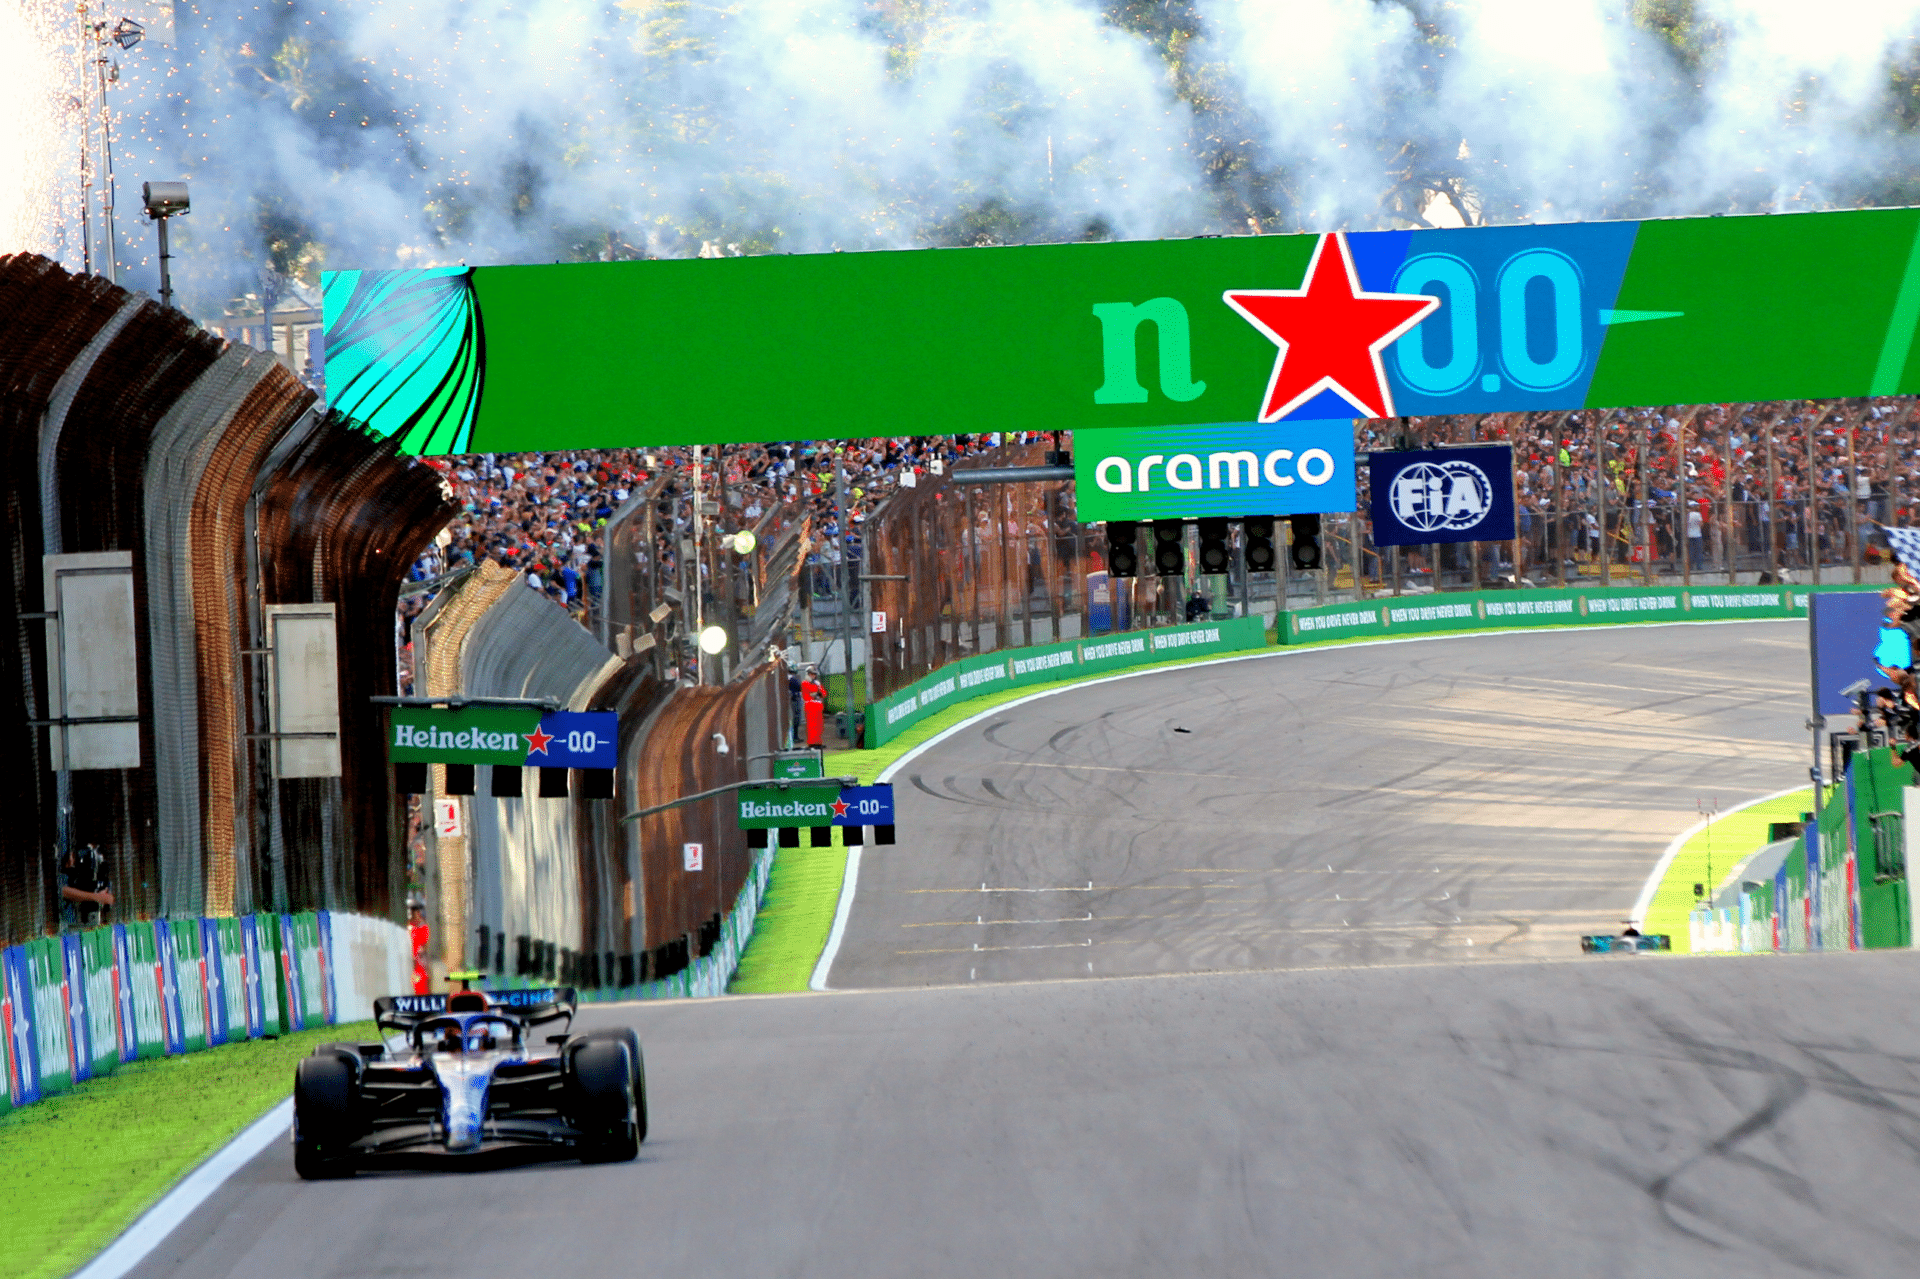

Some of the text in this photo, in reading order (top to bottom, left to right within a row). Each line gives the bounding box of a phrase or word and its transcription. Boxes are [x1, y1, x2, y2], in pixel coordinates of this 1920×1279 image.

[1092, 250, 1585, 405] n 0.0
[1095, 447, 1336, 493] aramco
[1588, 599, 1607, 613] WHEN
[1607, 598, 1620, 612] YOU
[1691, 595, 1709, 608] WHEN
[1710, 594, 1724, 607] YOU
[1391, 608, 1408, 622] WHEN
[1408, 607, 1420, 621] YOU
[1486, 602, 1504, 616] WHEN
[1504, 602, 1516, 615] YOU
[1299, 617, 1315, 631] WHEN
[1315, 616, 1326, 629] YOU
[394, 724, 597, 753] Heineken 0.0
[741, 801, 828, 818] Heineken
